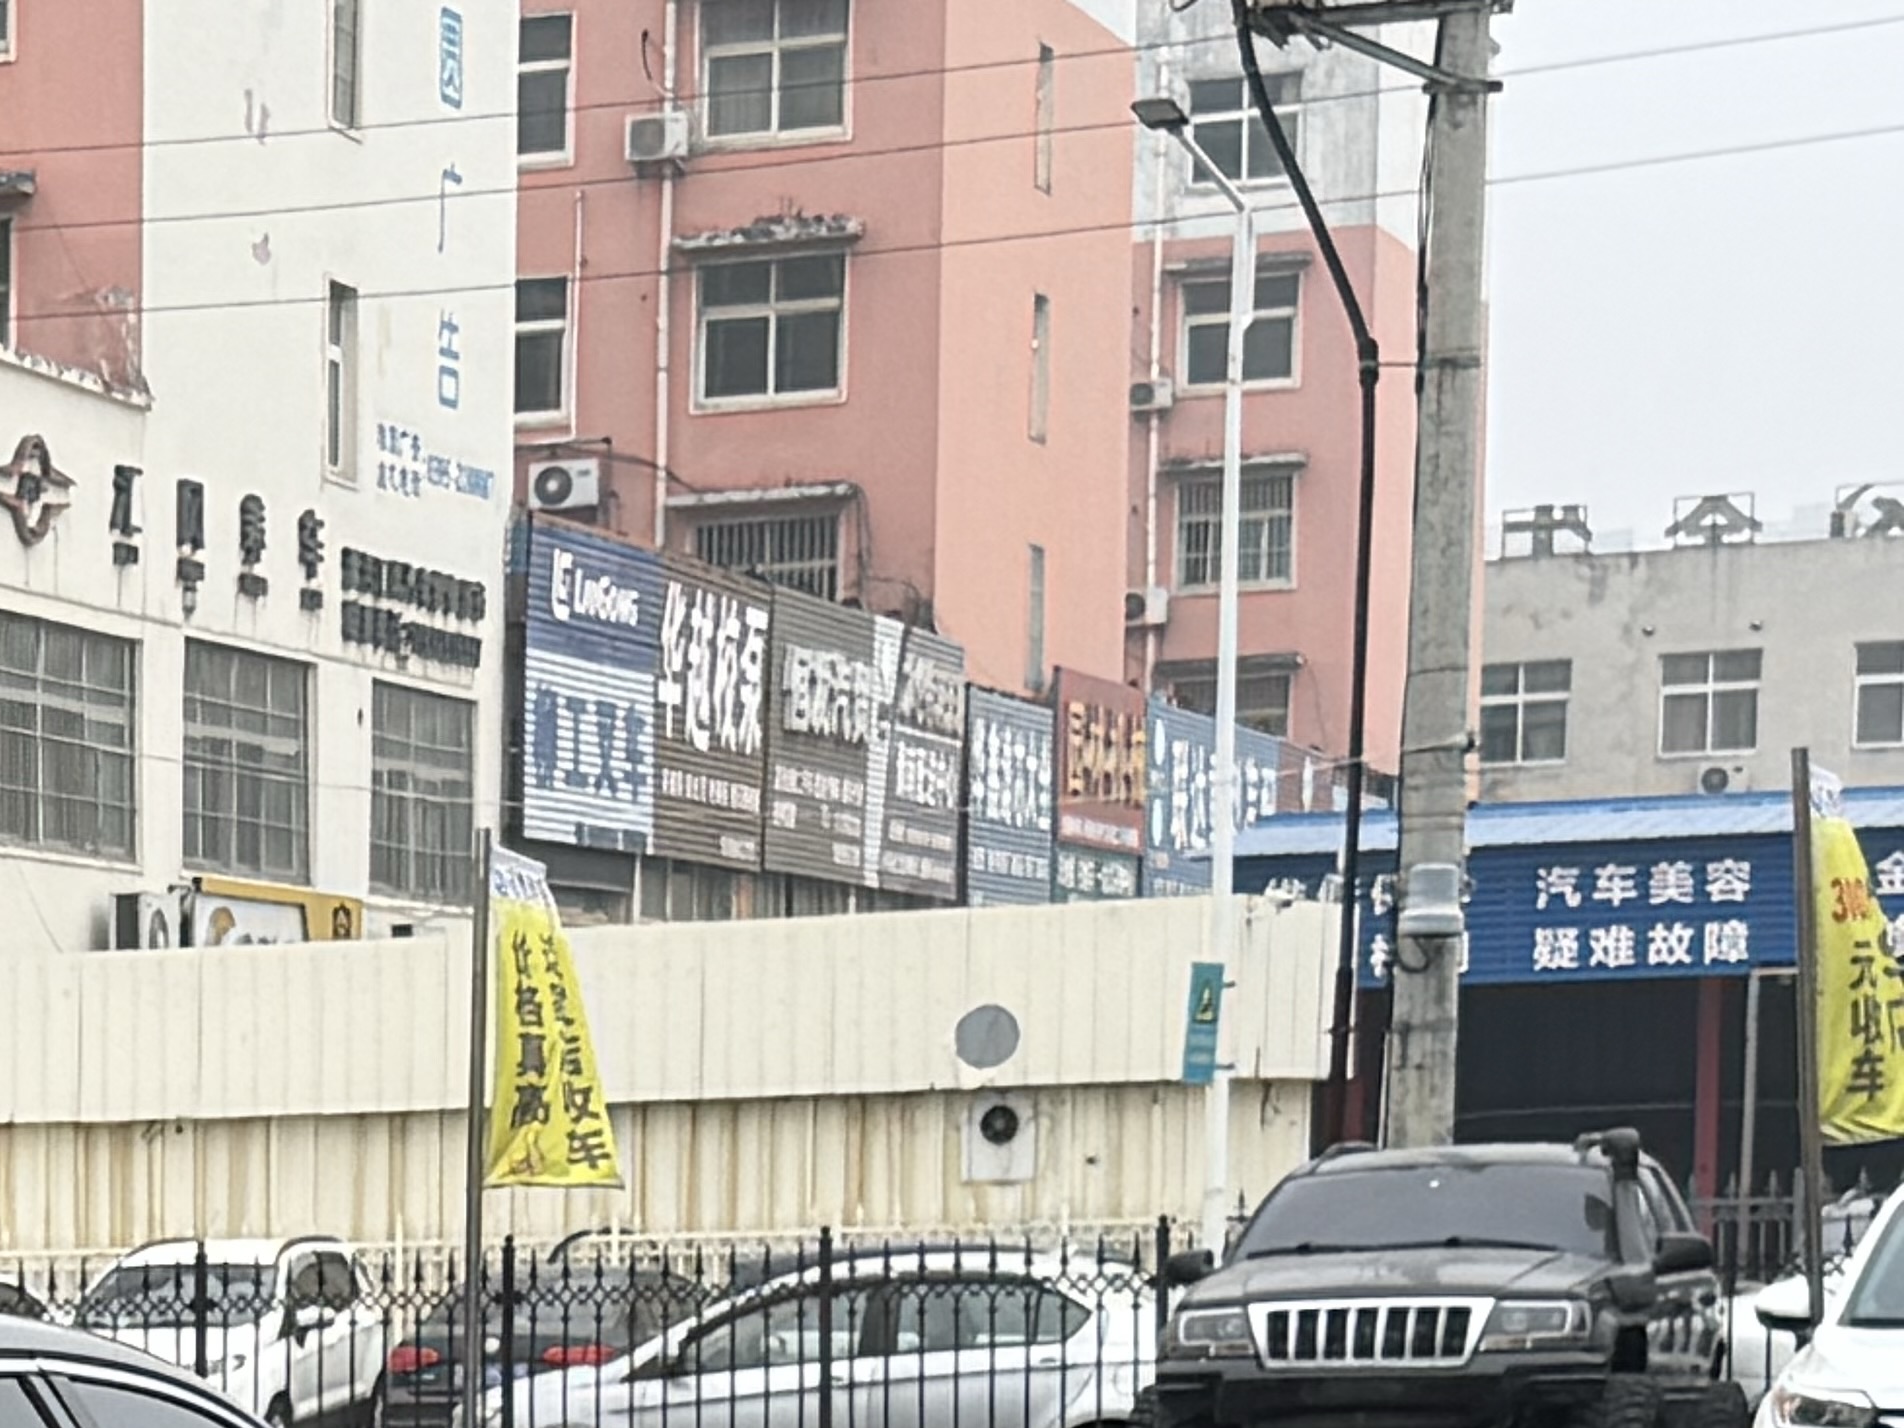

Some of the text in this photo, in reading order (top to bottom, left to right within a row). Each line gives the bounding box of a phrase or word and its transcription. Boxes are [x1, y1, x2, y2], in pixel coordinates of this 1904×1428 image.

[1534, 857, 1752, 911] 汽车美容
[1532, 917, 1750, 974] 疑难故障
